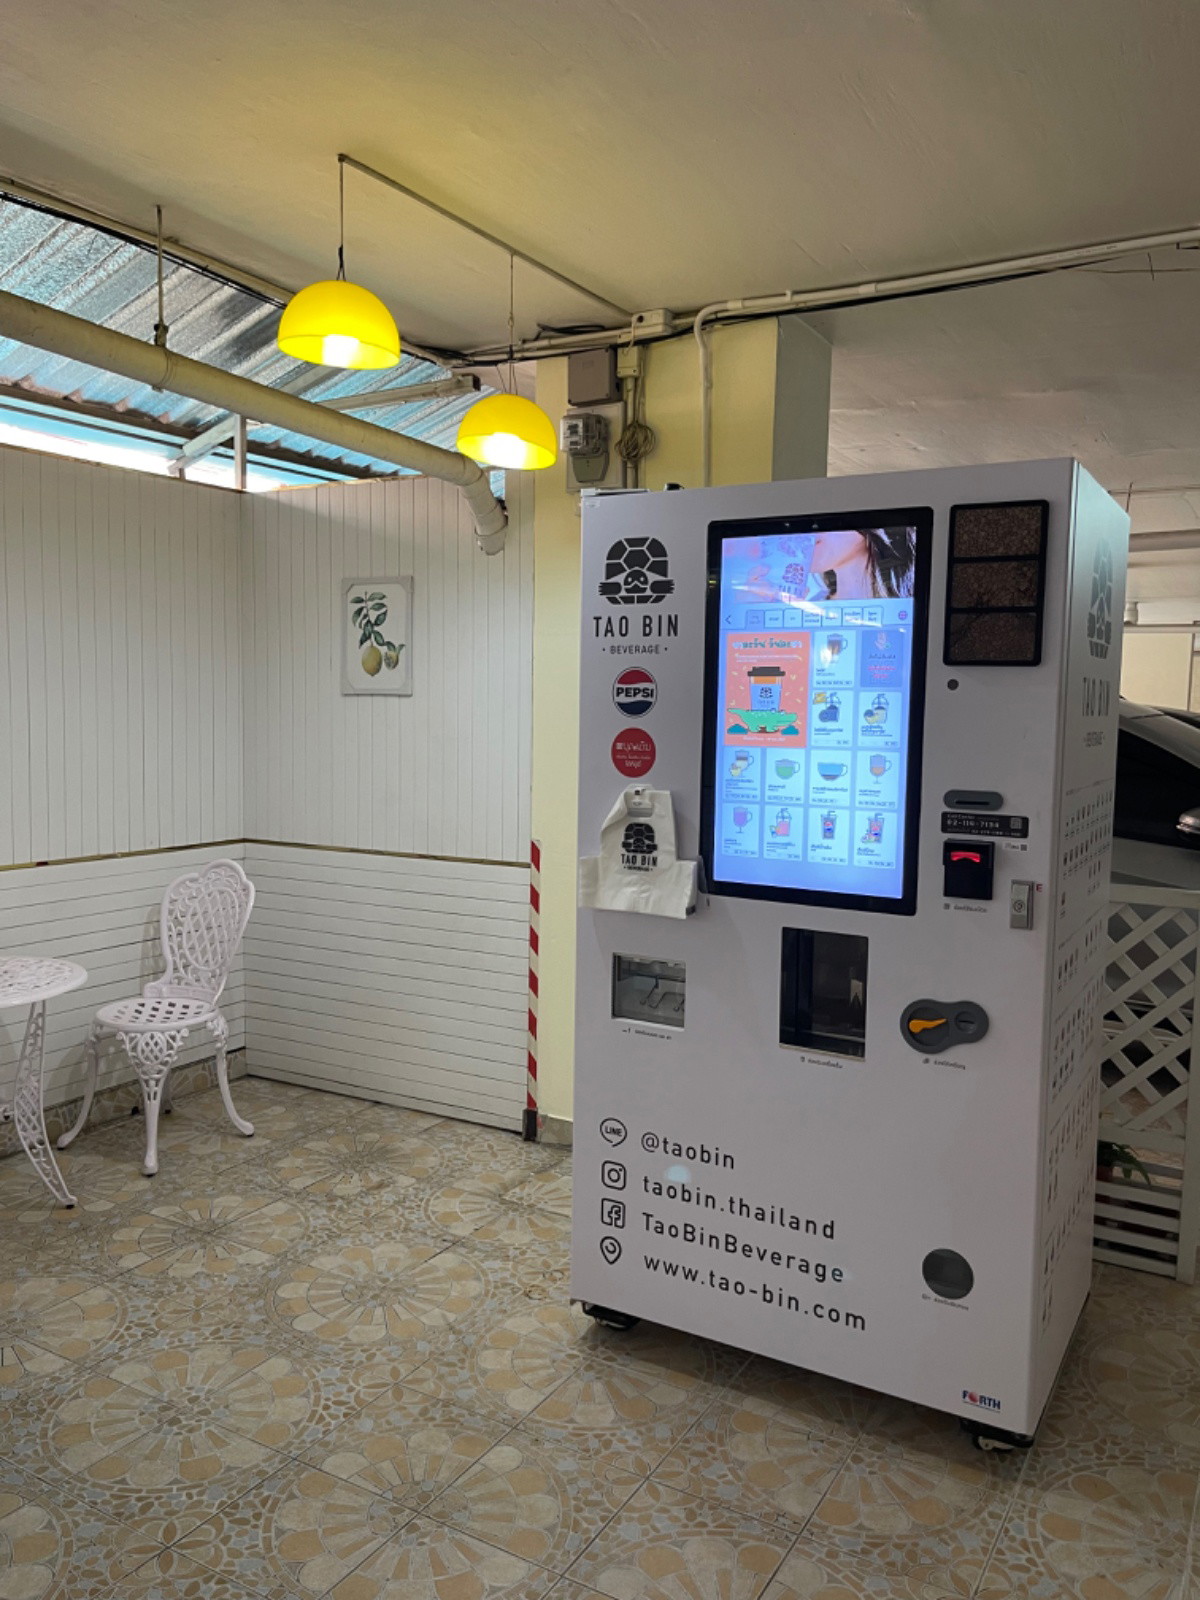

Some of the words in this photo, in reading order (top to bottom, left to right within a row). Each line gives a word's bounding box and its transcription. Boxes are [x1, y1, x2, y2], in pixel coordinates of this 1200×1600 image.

[593, 616, 628, 637] TAO
[642, 614, 679, 637] BIN
[610, 645, 660, 655] BEVERAGE
[616, 686, 655, 699] PEPSI
[621, 853, 637, 866] TAO
[640, 855, 658, 868] BIN
[605, 1126, 623, 1137] LINE
[641, 1132, 735, 1170] @taobin
[642, 1175, 835, 1240] taobin.thailand
[642, 1212, 844, 1283] TaoBinBeverage
[643, 1254, 866, 1331] www.tao-bin.com
[963, 1390, 1001, 1409] FORTH
